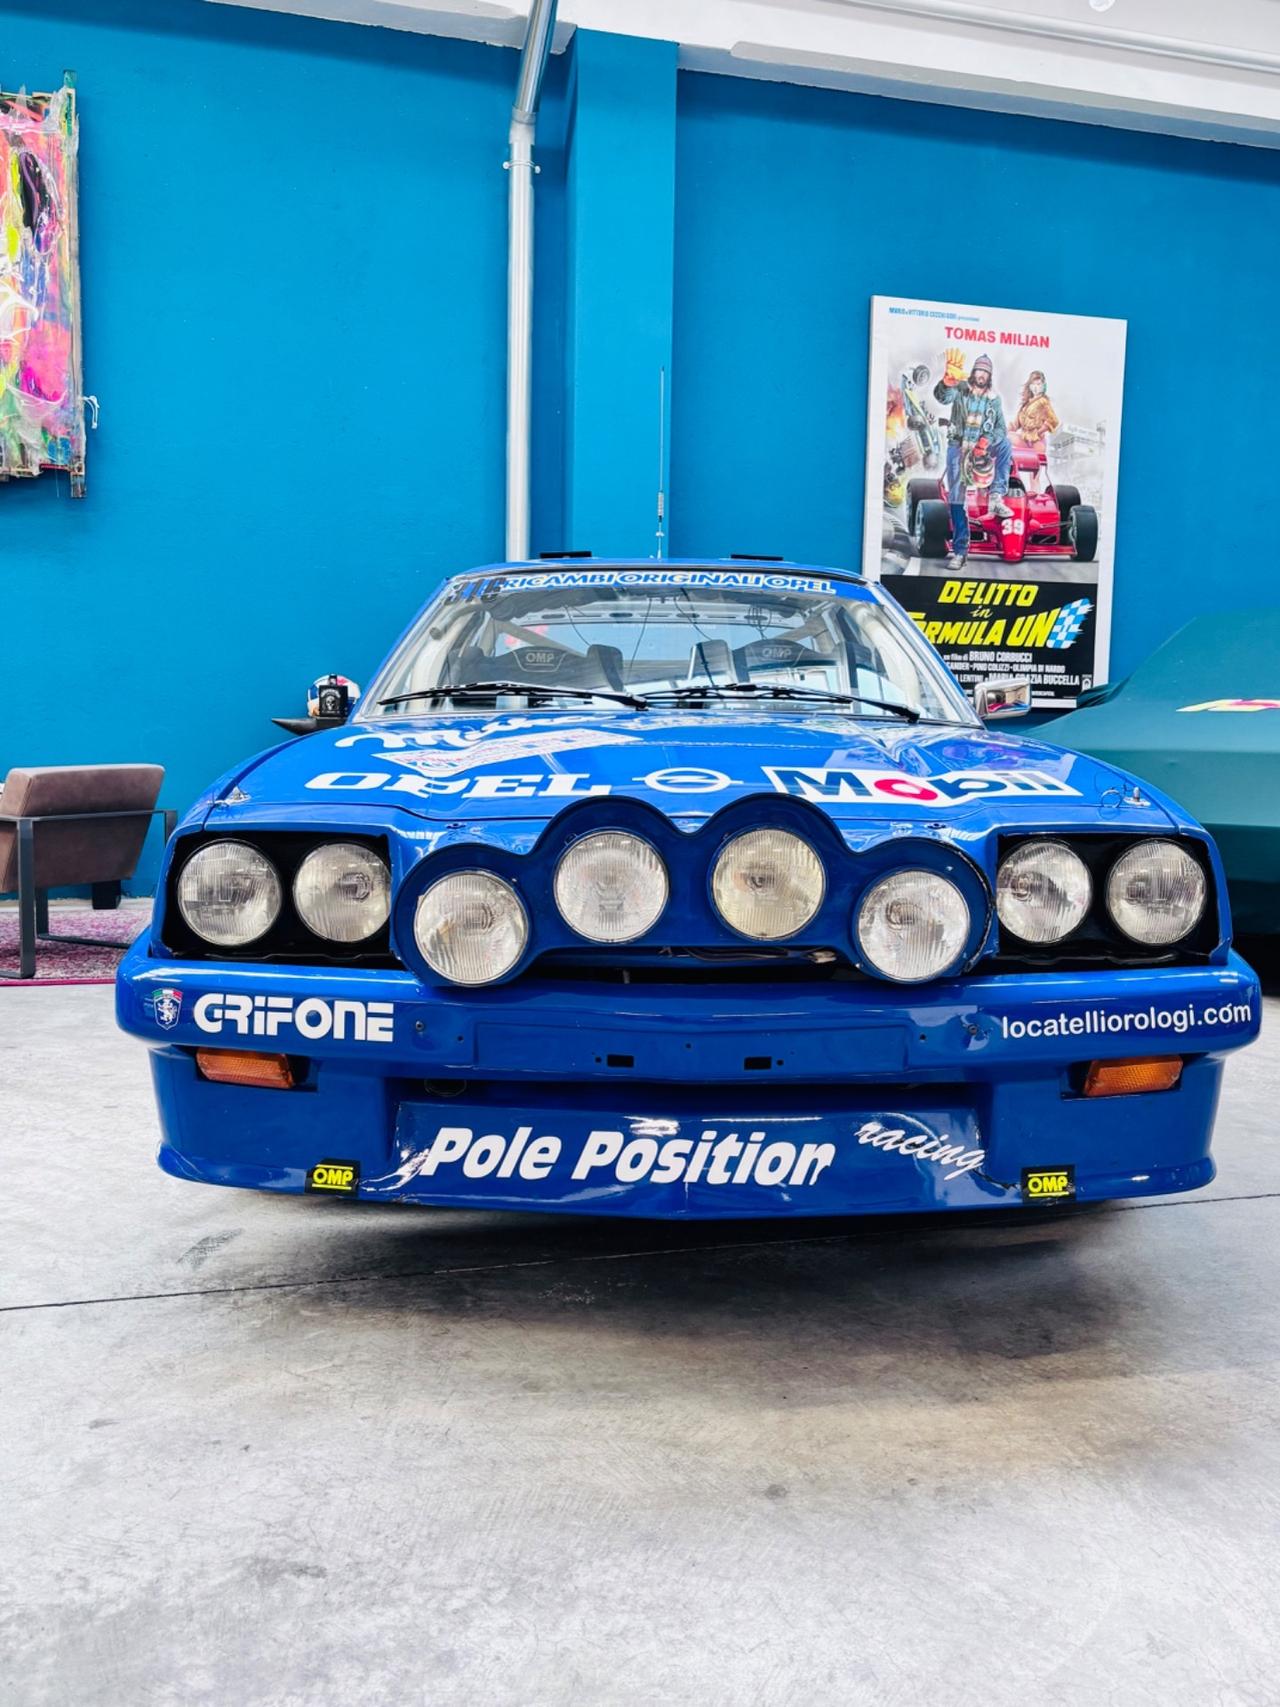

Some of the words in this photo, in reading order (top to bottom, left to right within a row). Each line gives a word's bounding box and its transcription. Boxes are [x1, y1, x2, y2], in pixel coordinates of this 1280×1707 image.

[944, 326, 996, 343] TOMAS
[1000, 331, 1050, 348] MILIAN
[1001, 518, 1025, 536] 39
[501, 572, 613, 589] RICAMBI
[615, 571, 761, 588] ORIGINALI
[764, 573, 837, 595] OPEL
[937, 580, 1039, 607] DELITTO
[969, 605, 994, 619] in
[525, 651, 555, 664] OMP
[969, 650, 995, 662] BRUNO
[996, 651, 1033, 663] CORBUCCI
[1043, 675, 1080, 686] BUCCELLA
[304, 771, 612, 799] OPEL
[773, 769, 1064, 801] Mobil
[193, 992, 394, 1042] GRIFONE
[1002, 1003, 1251, 1039] locatelliorologi.com
[419, 1126, 562, 1181] Pole
[571, 1130, 836, 1187] Position
[856, 1121, 986, 1182] racing
[312, 1167, 354, 1185] OMP
[1027, 1175, 1068, 1193] OMP
